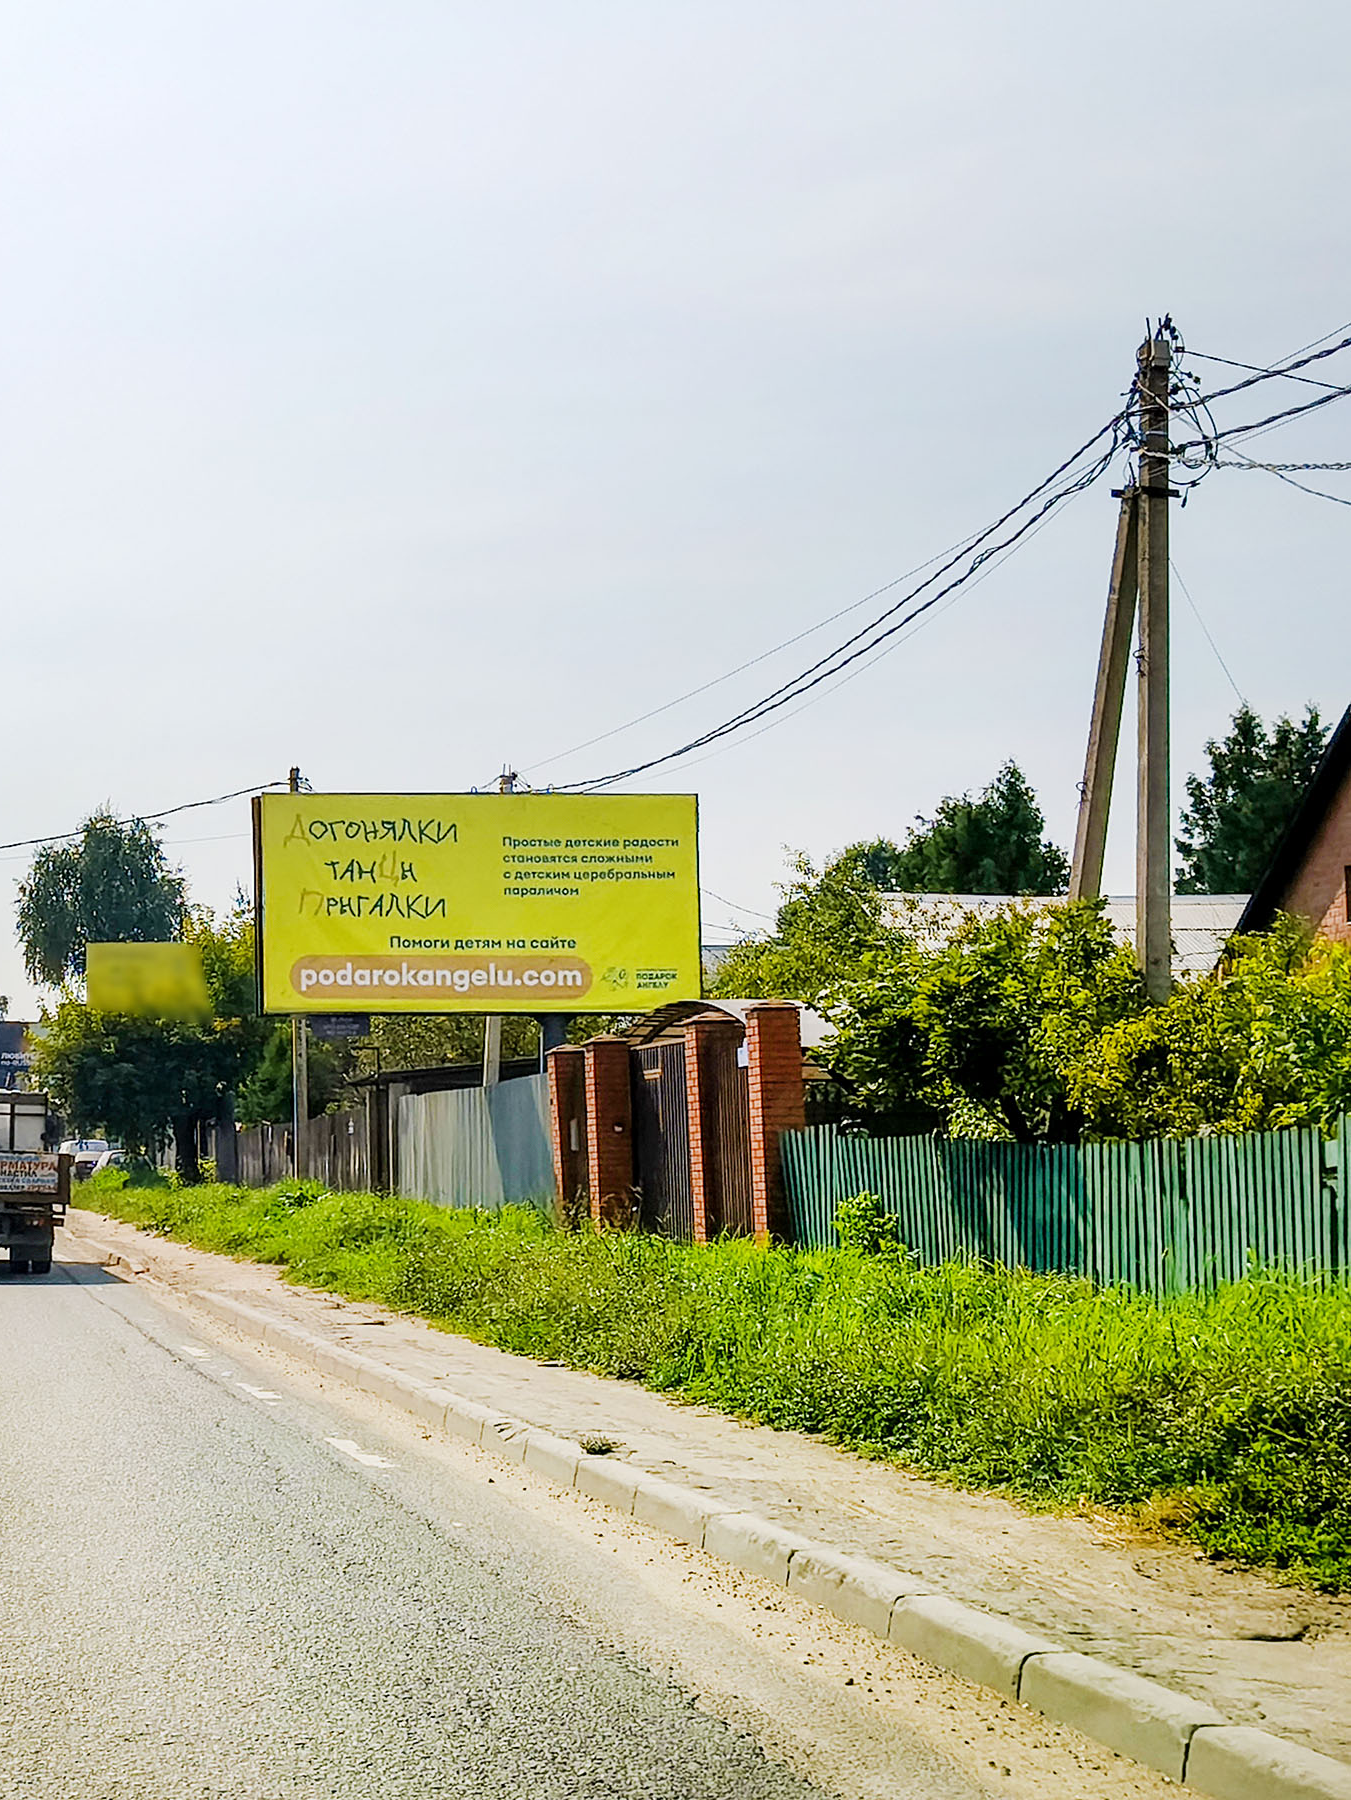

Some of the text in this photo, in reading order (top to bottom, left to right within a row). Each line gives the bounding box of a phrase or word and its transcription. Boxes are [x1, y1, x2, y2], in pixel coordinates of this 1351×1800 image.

[284, 813, 457, 848] ДОГОНЯЛКИ
[502, 836, 679, 849] Простые детские радости
[502, 853, 653, 864] становятся сложными
[503, 868, 676, 882] с детским церебральным
[503, 886, 580, 897] параличом
[299, 888, 446, 918] ПРЫГАЛКИ
[389, 936, 577, 950] Помоги детям на сайте
[300, 962, 582, 992] podarokangelu.com
